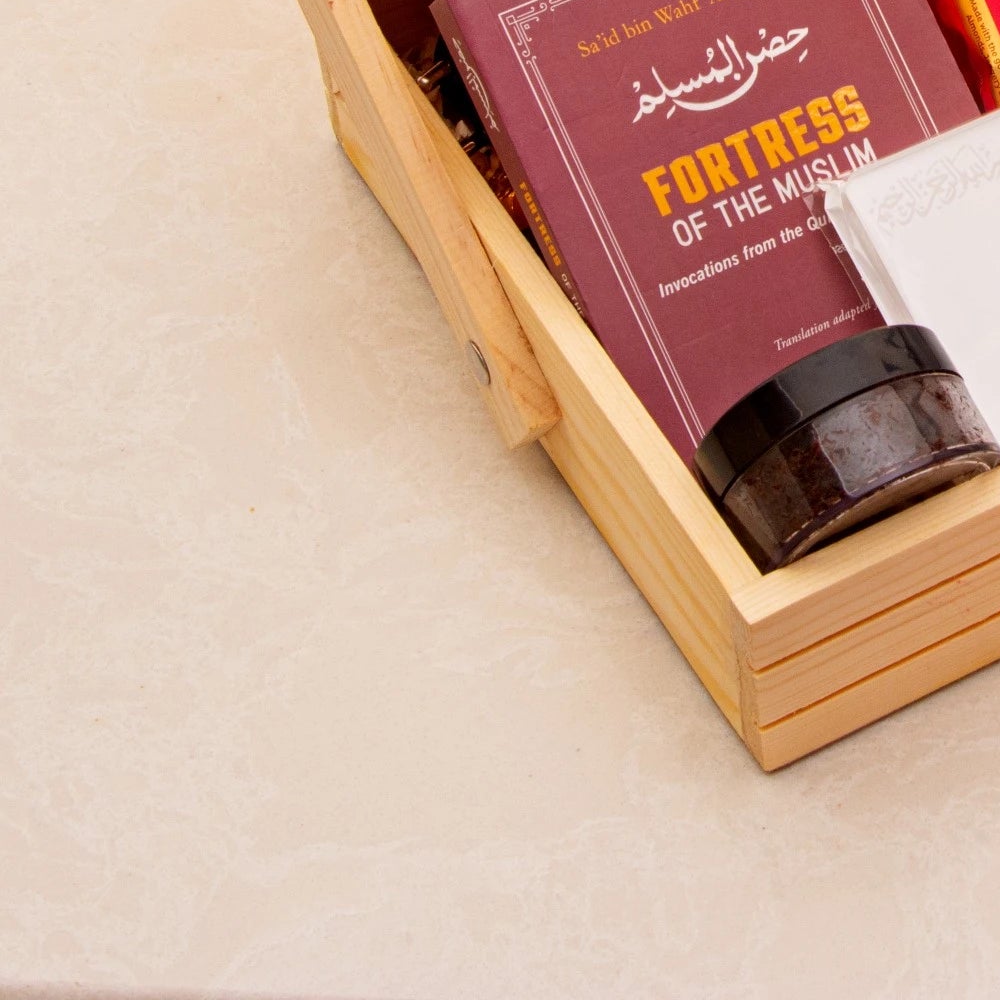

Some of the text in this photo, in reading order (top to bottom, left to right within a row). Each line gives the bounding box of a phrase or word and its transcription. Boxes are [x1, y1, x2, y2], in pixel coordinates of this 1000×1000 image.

[577, 28, 621, 58] Sa'id
[622, 19, 654, 40] bin
[980, 23, 992, 42] with
[988, 42, 998, 57] the
[641, 85, 871, 217] FORTRESS
[672, 137, 878, 247] OF THE MUSLIM
[520, 181, 561, 266] FORTRESS
[561, 273, 573, 290] OF
[658, 253, 740, 298] Invocations
[742, 237, 777, 261] from
[780, 225, 803, 244] the
[773, 297, 872, 351] Translation adapted
